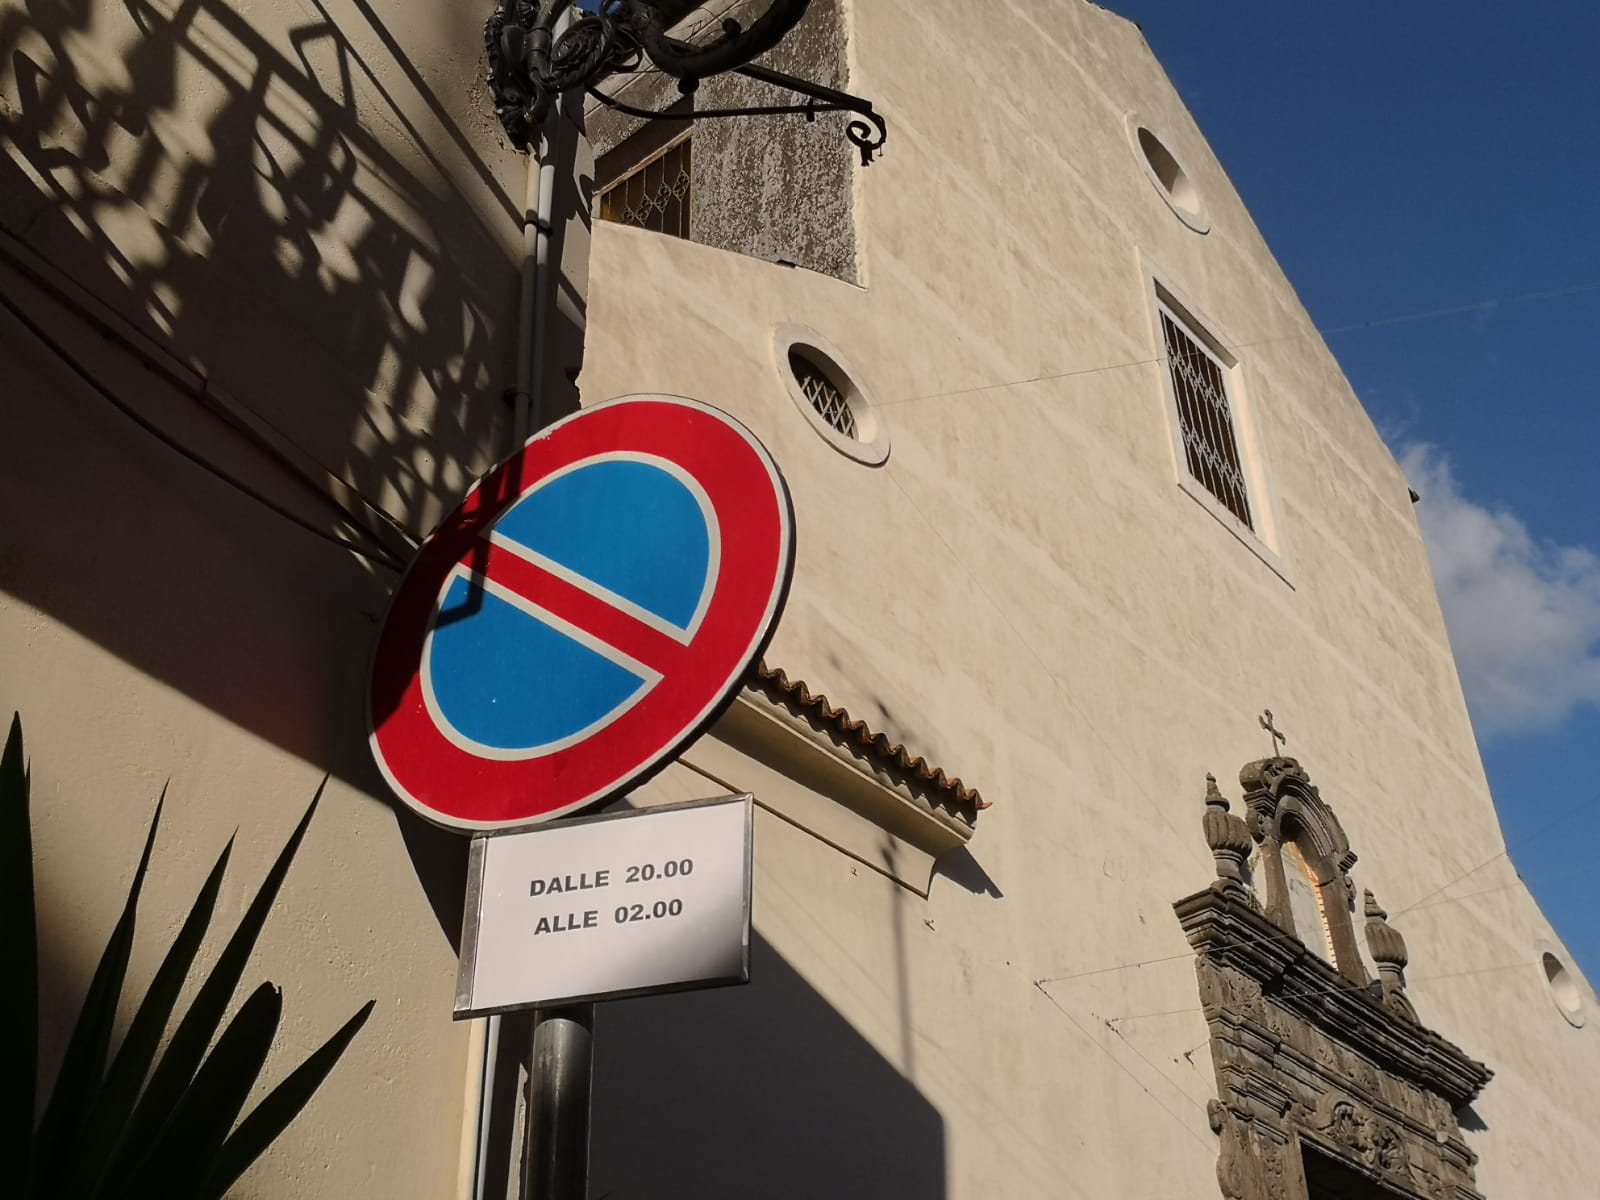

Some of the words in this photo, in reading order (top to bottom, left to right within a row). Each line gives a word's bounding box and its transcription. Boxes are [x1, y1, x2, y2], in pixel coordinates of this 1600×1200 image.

[529, 870, 610, 896] DALLE
[625, 859, 694, 884] 20.00
[533, 910, 598, 935] ALLE
[614, 898, 683, 924] 02.00
